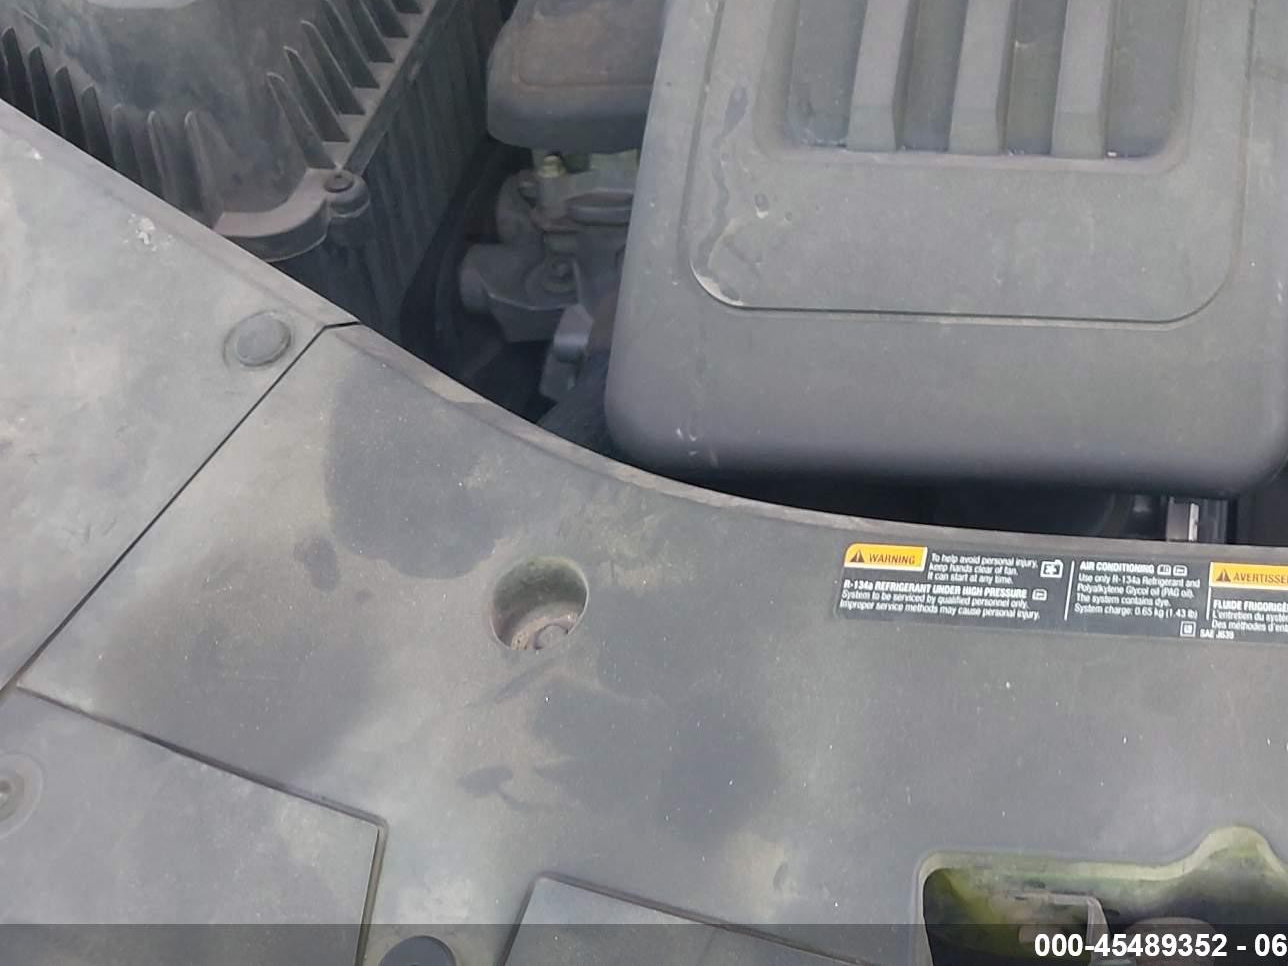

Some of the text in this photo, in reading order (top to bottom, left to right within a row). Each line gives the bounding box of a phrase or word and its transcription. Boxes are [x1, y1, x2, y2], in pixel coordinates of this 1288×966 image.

[869, 554, 916, 564] WARNING
[932, 553, 940, 561] To
[941, 553, 959, 564] help
[960, 555, 980, 564] avoid
[980, 556, 1014, 568] personal
[949, 565, 973, 574] hands
[974, 566, 994, 575] clear
[994, 567, 1003, 575] of
[1080, 561, 1155, 574] AIR CONDITIONING
[934, 573, 949, 581] can
[950, 573, 968, 582] start
[969, 573, 978, 582] at
[978, 575, 994, 584] any
[1078, 573, 1201, 587] Use only R-134a Refrigerant and
[843, 579, 1028, 598] R-134a REFRIGERANT UNDER HIGH PRESSURE
[1077, 583, 1124, 595] Polyalkylene
[1126, 586, 1150, 596] Glycol
[1150, 587, 1160, 596] oil
[1160, 588, 1180, 598] (PAG
[841, 590, 871, 601] System
[872, 592, 880, 601] to
[880, 592, 892, 601] be
[892, 593, 926, 603] serviced
[926, 595, 936, 604] by
[937, 595, 971, 606] qualified
[971, 597, 1010, 608] personnel
[1076, 593, 1090, 602] The
[1092, 594, 1120, 605] system
[1121, 596, 1154, 606] contains
[1212, 600, 1243, 610] FLUIDE
[839, 600, 874, 611] Improper
[875, 602, 904, 612] service
[905, 604, 939, 613] methods
[939, 606, 957, 615] may
[957, 607, 981, 616] cause
[982, 608, 1016, 619] personal
[1074, 603, 1103, 614] System
[1153, 607, 1164, 617] kg
[1254, 613, 1265, 622] du
[1212, 620, 1227, 629] Des
